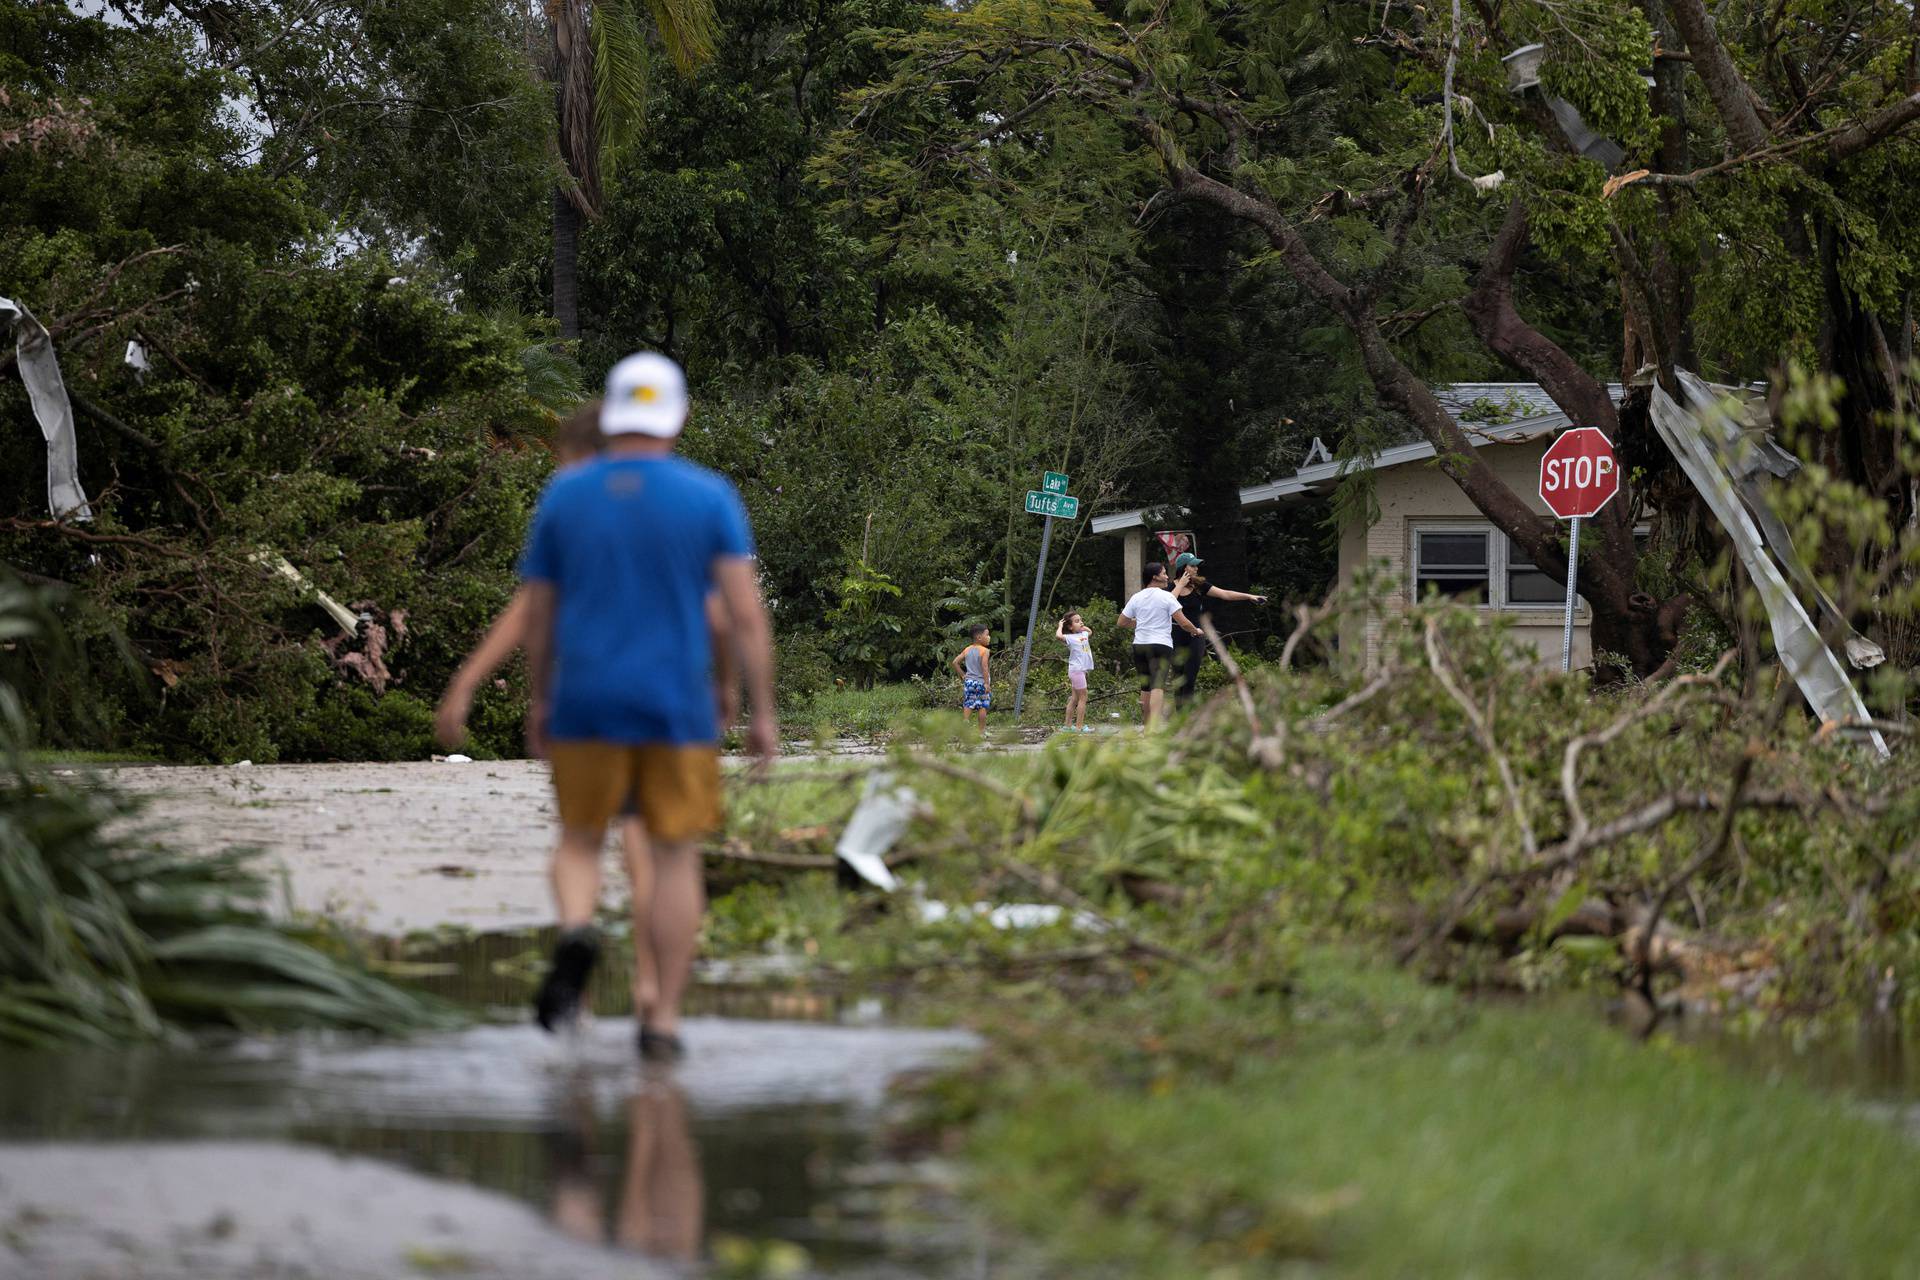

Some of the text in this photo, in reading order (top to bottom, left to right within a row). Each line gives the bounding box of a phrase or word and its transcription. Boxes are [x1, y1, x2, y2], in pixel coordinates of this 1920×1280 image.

[1545, 455, 1613, 491] STOP
[1045, 475, 1061, 490] Lake
[1030, 495, 1057, 511] Tufts
